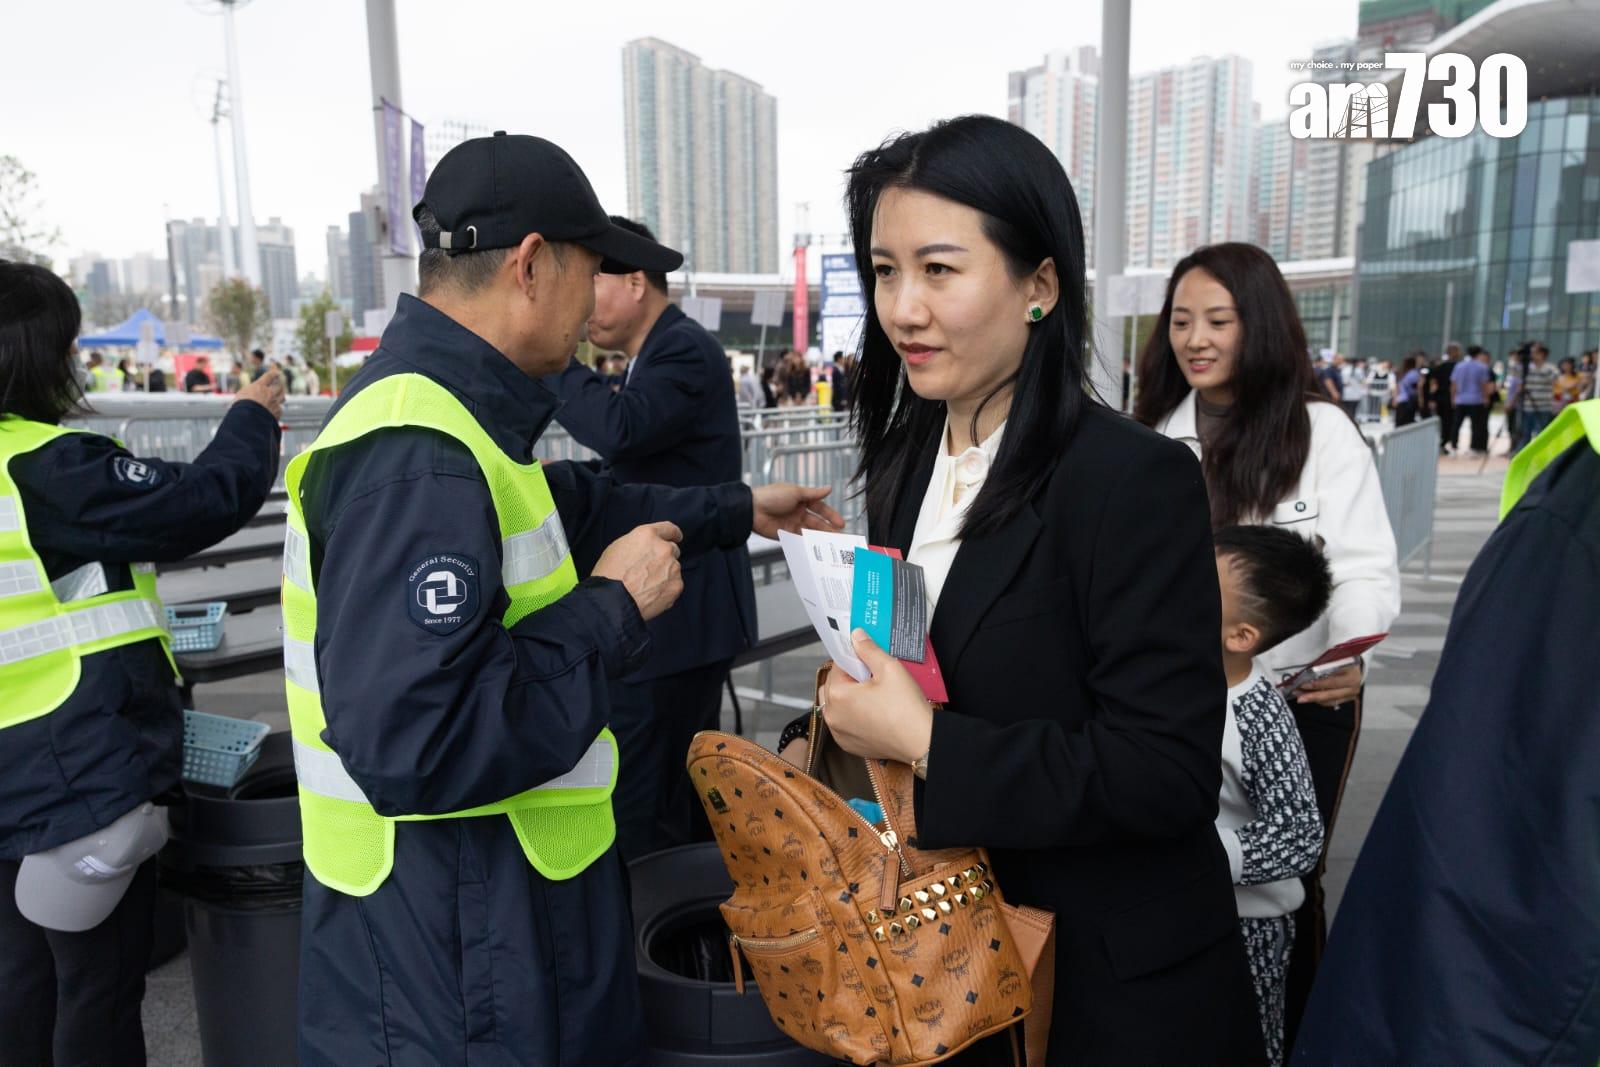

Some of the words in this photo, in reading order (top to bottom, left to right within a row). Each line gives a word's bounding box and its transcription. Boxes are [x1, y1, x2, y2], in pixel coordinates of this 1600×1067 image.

[409, 557, 438, 582] General
[440, 556, 475, 576] Security
[424, 617, 442, 625] Since
[443, 616, 462, 624] 1977
